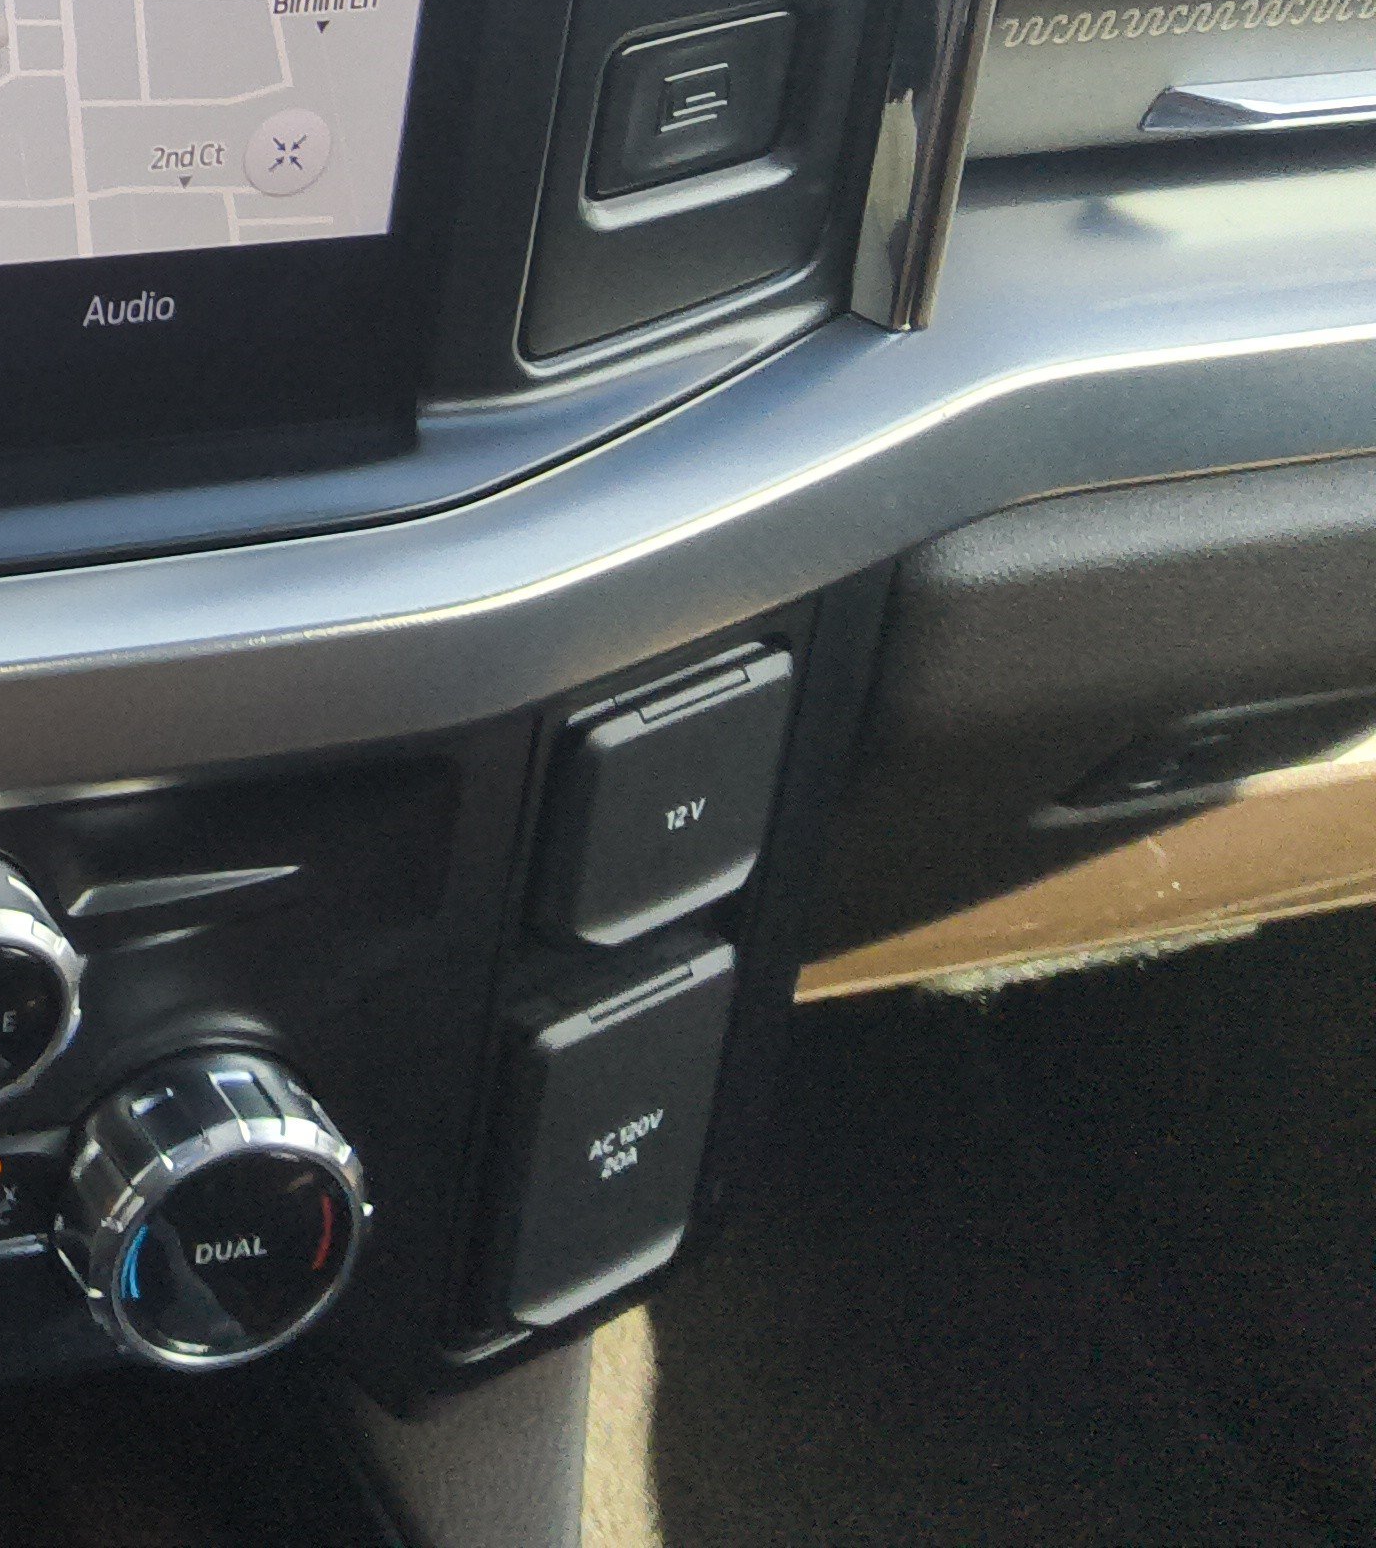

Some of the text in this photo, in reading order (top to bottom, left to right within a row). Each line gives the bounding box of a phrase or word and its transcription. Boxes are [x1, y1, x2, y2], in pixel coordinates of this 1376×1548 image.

[151, 144, 224, 168] 2nd Ct
[83, 291, 175, 327] Audio
[589, 1132, 615, 1161] AC
[195, 1237, 268, 1265] DUAL
